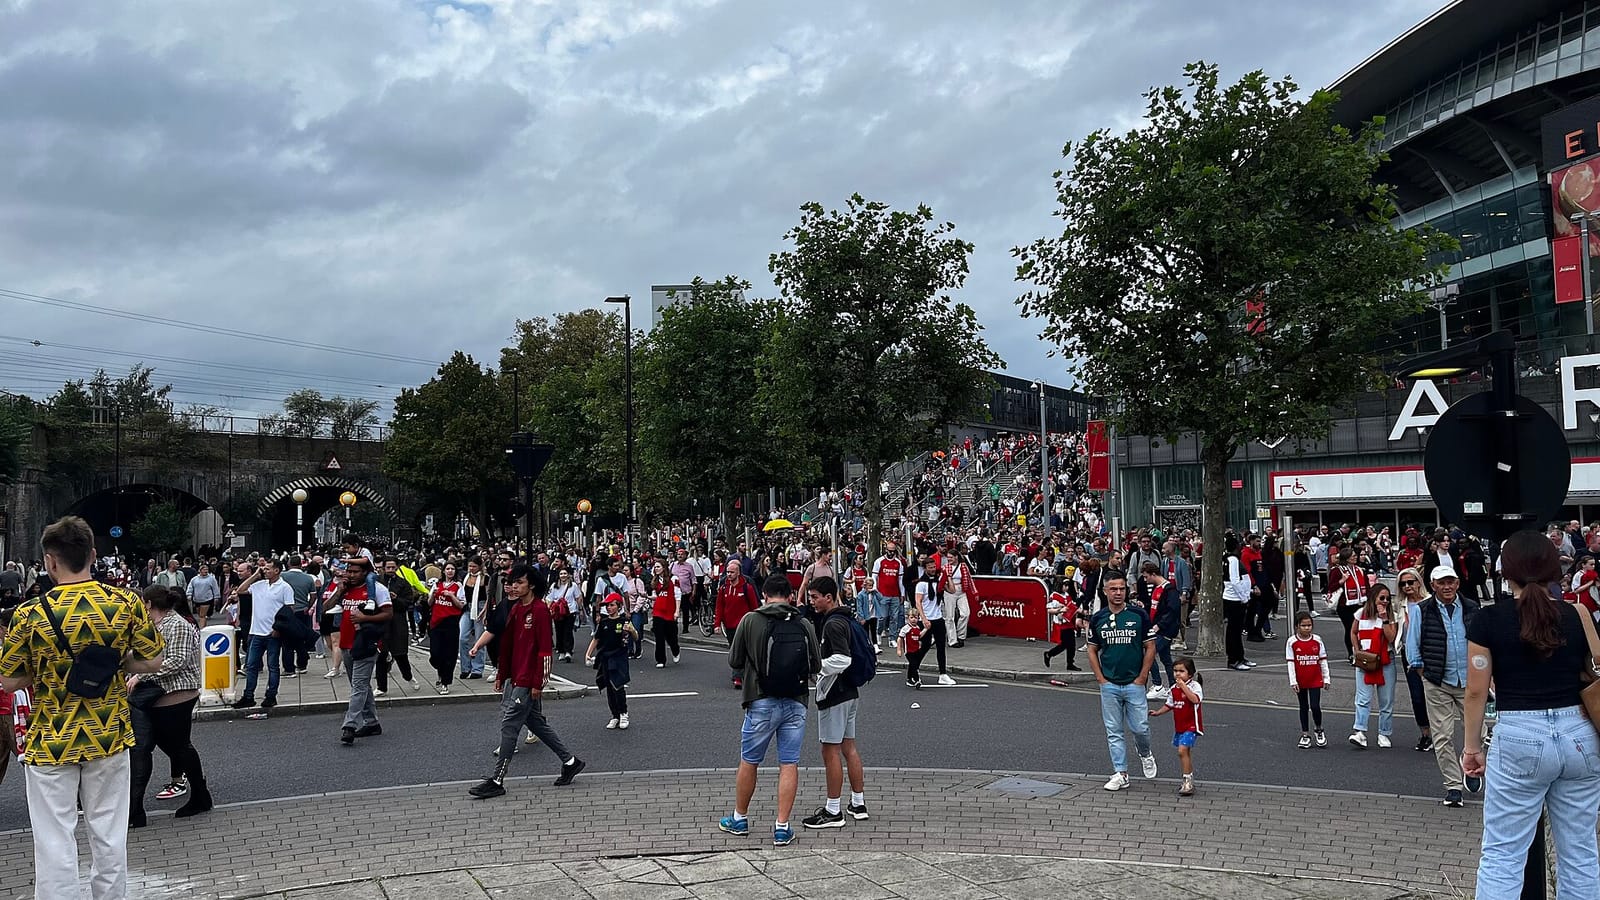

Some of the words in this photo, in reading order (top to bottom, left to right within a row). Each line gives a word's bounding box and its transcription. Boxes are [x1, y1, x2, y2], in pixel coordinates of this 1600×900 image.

[1565, 121, 1600, 159] E
[977, 600, 1025, 619] Arsenal
[1101, 629, 1136, 638] Emirates
